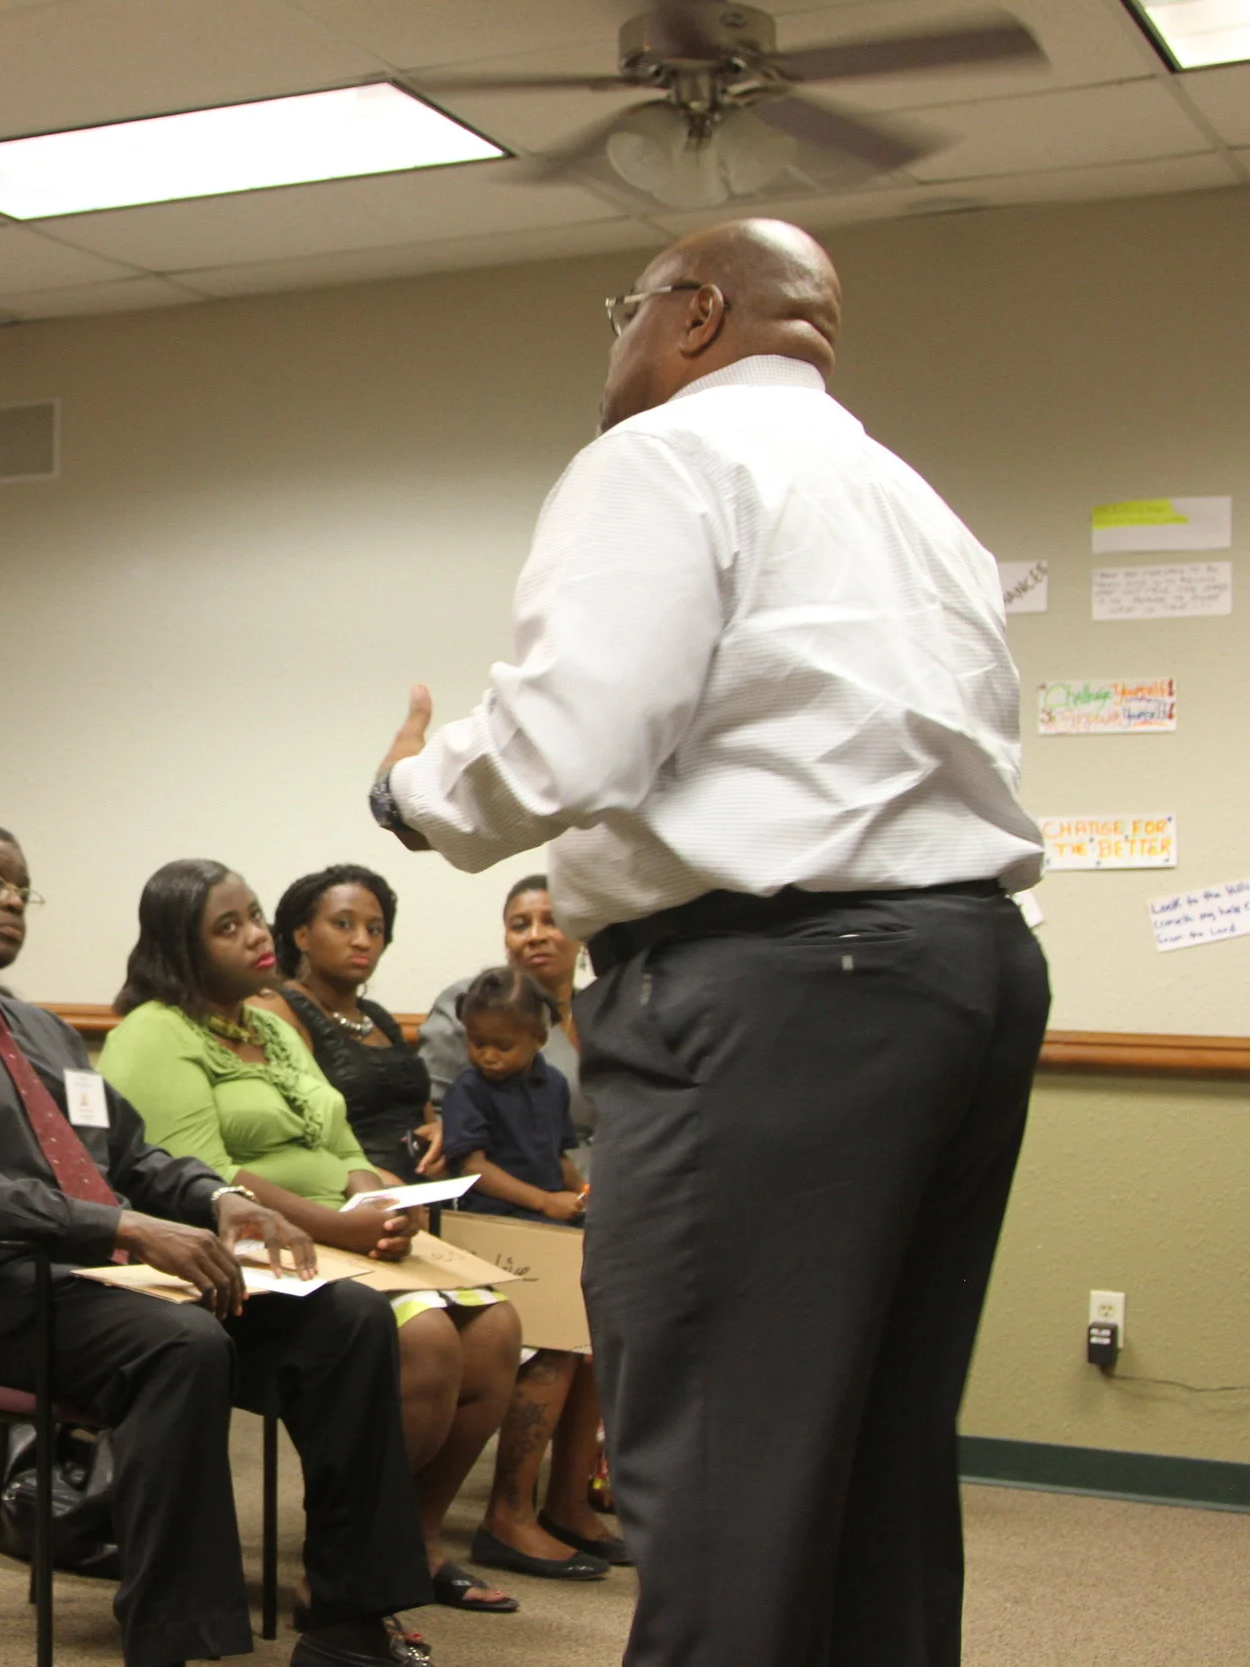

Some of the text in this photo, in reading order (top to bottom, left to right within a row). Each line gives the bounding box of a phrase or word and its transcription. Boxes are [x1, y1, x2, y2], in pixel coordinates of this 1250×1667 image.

[1042, 818, 1167, 839] CHANGE FOR
[1053, 838, 1172, 859] THE BETTER
